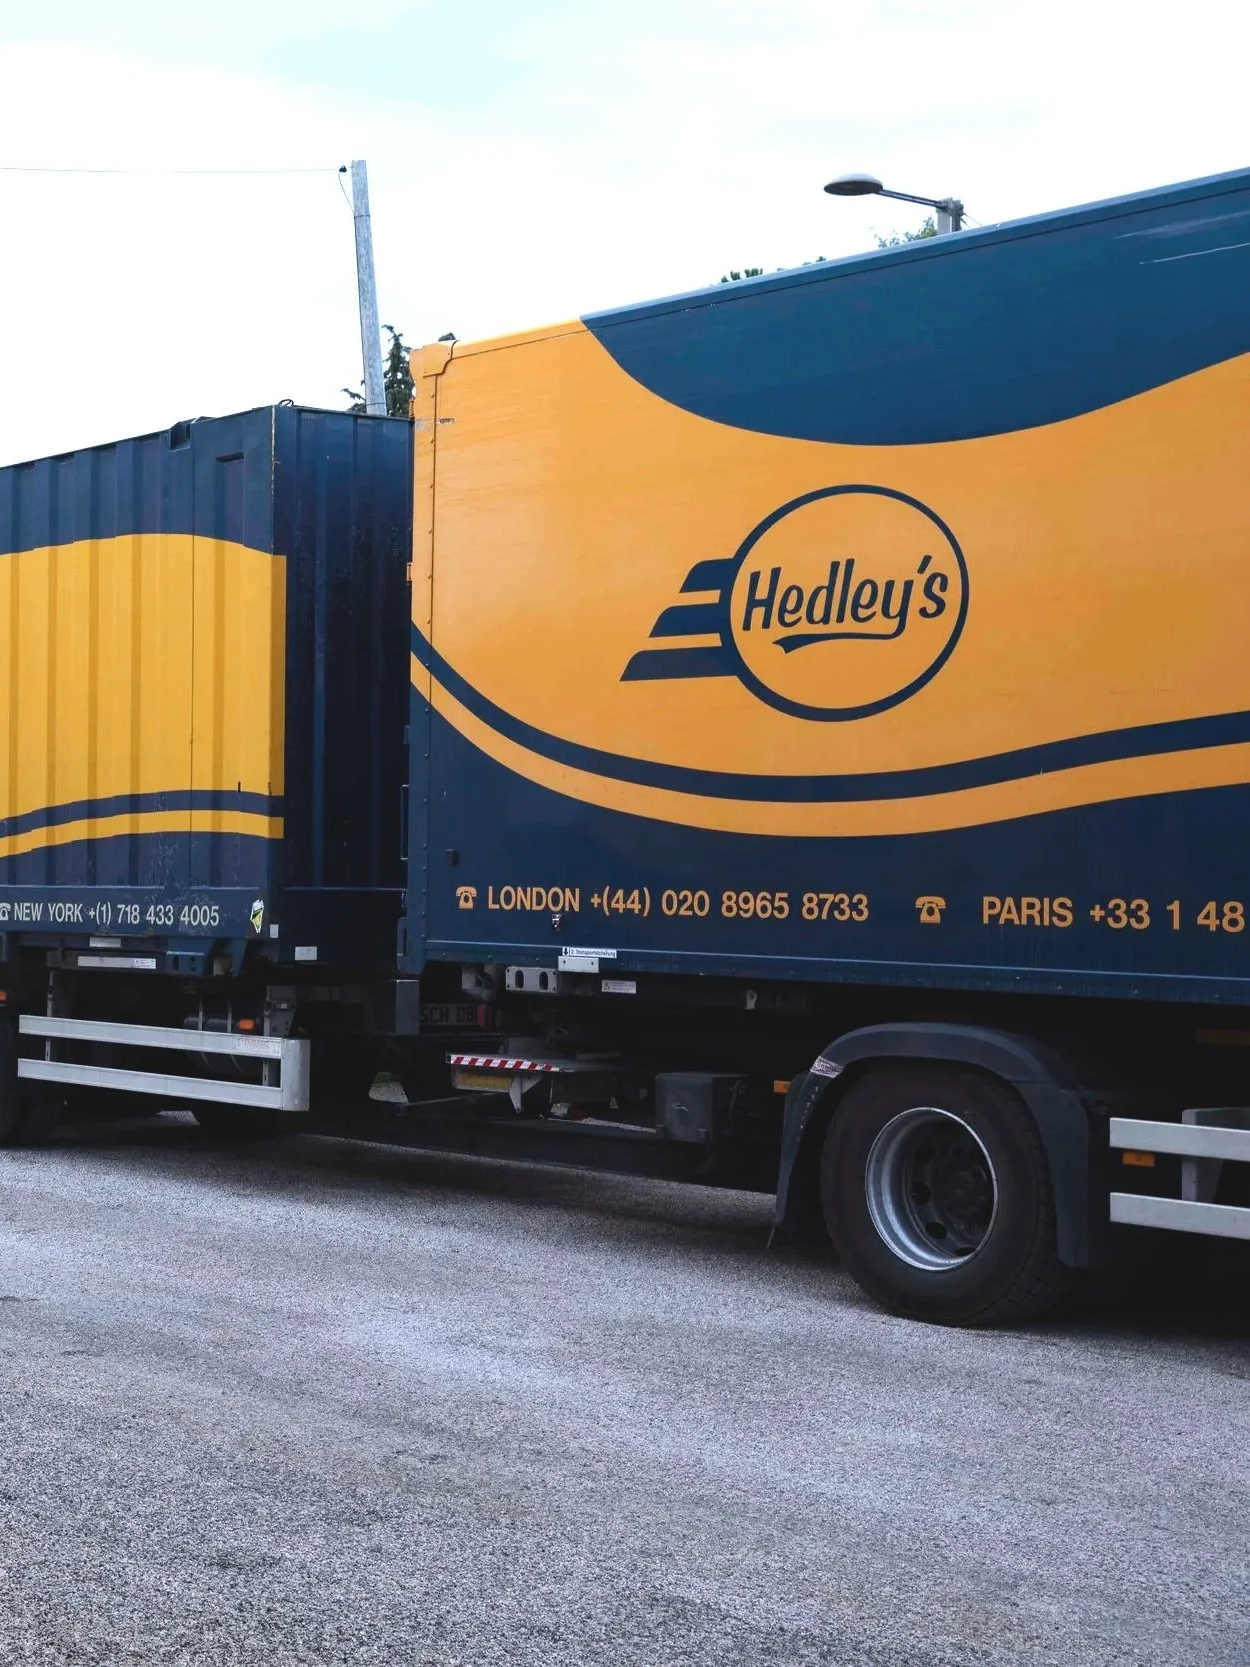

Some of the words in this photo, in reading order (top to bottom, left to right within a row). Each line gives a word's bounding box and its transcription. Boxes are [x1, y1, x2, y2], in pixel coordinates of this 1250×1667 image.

[742, 554, 949, 654] Hedley's
[14, 902, 43, 921] NEW
[48, 902, 83, 923] YORK
[88, 902, 112, 925] +(1)
[117, 904, 140, 925] 718
[146, 904, 174, 925] 433
[180, 904, 219, 927] 4005
[488, 885, 580, 912] LONDON
[590, 886, 650, 917] +(44)
[661, 889, 710, 917] 020
[721, 891, 789, 920] 8965
[802, 891, 869, 922] 8733
[982, 896, 1074, 928] PARIS
[1089, 898, 1150, 930] +33
[1166, 900, 1181, 931] 1
[1196, 901, 1246, 933] 48
